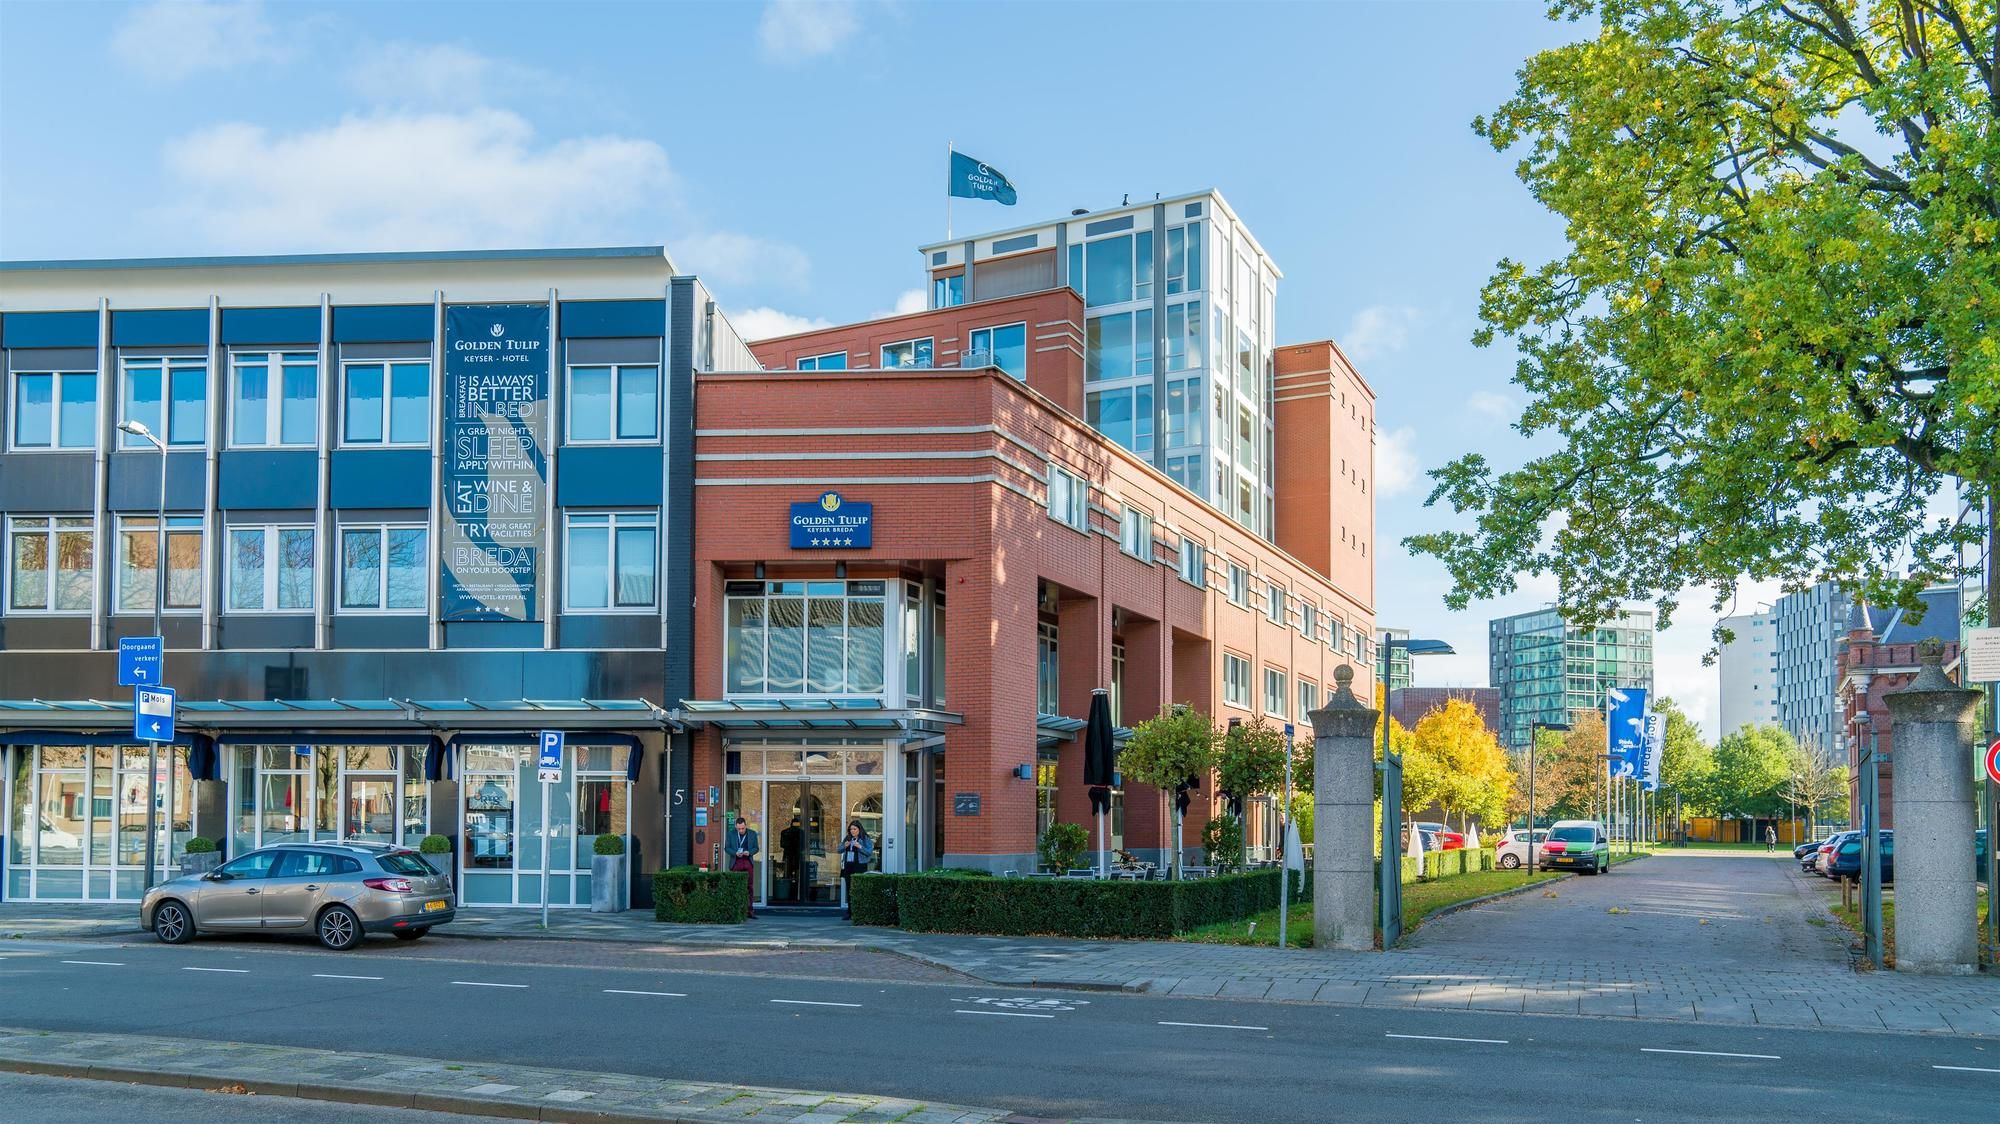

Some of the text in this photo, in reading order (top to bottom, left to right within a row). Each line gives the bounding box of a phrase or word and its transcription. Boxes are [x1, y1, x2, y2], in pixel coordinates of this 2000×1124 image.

[455, 340, 540, 350] GOLDEN TULIP
[469, 375, 534, 386] IS ALWAYS
[468, 386, 533, 401] BETTER
[468, 401, 534, 418] IN BED
[467, 427, 495, 435] GREAT
[457, 436, 533, 460] SLEEP
[458, 460, 533, 470] APPLY WITHIN
[473, 480, 532, 493] WINE &
[457, 480, 472, 513] EAT
[473, 494, 532, 513] DINE
[793, 515, 868, 525] GOLDEN TULIP
[457, 523, 490, 537] TRY
[456, 547, 531, 566] BREDA
[544, 733, 559, 753] P
[673, 789, 685, 805] 5
